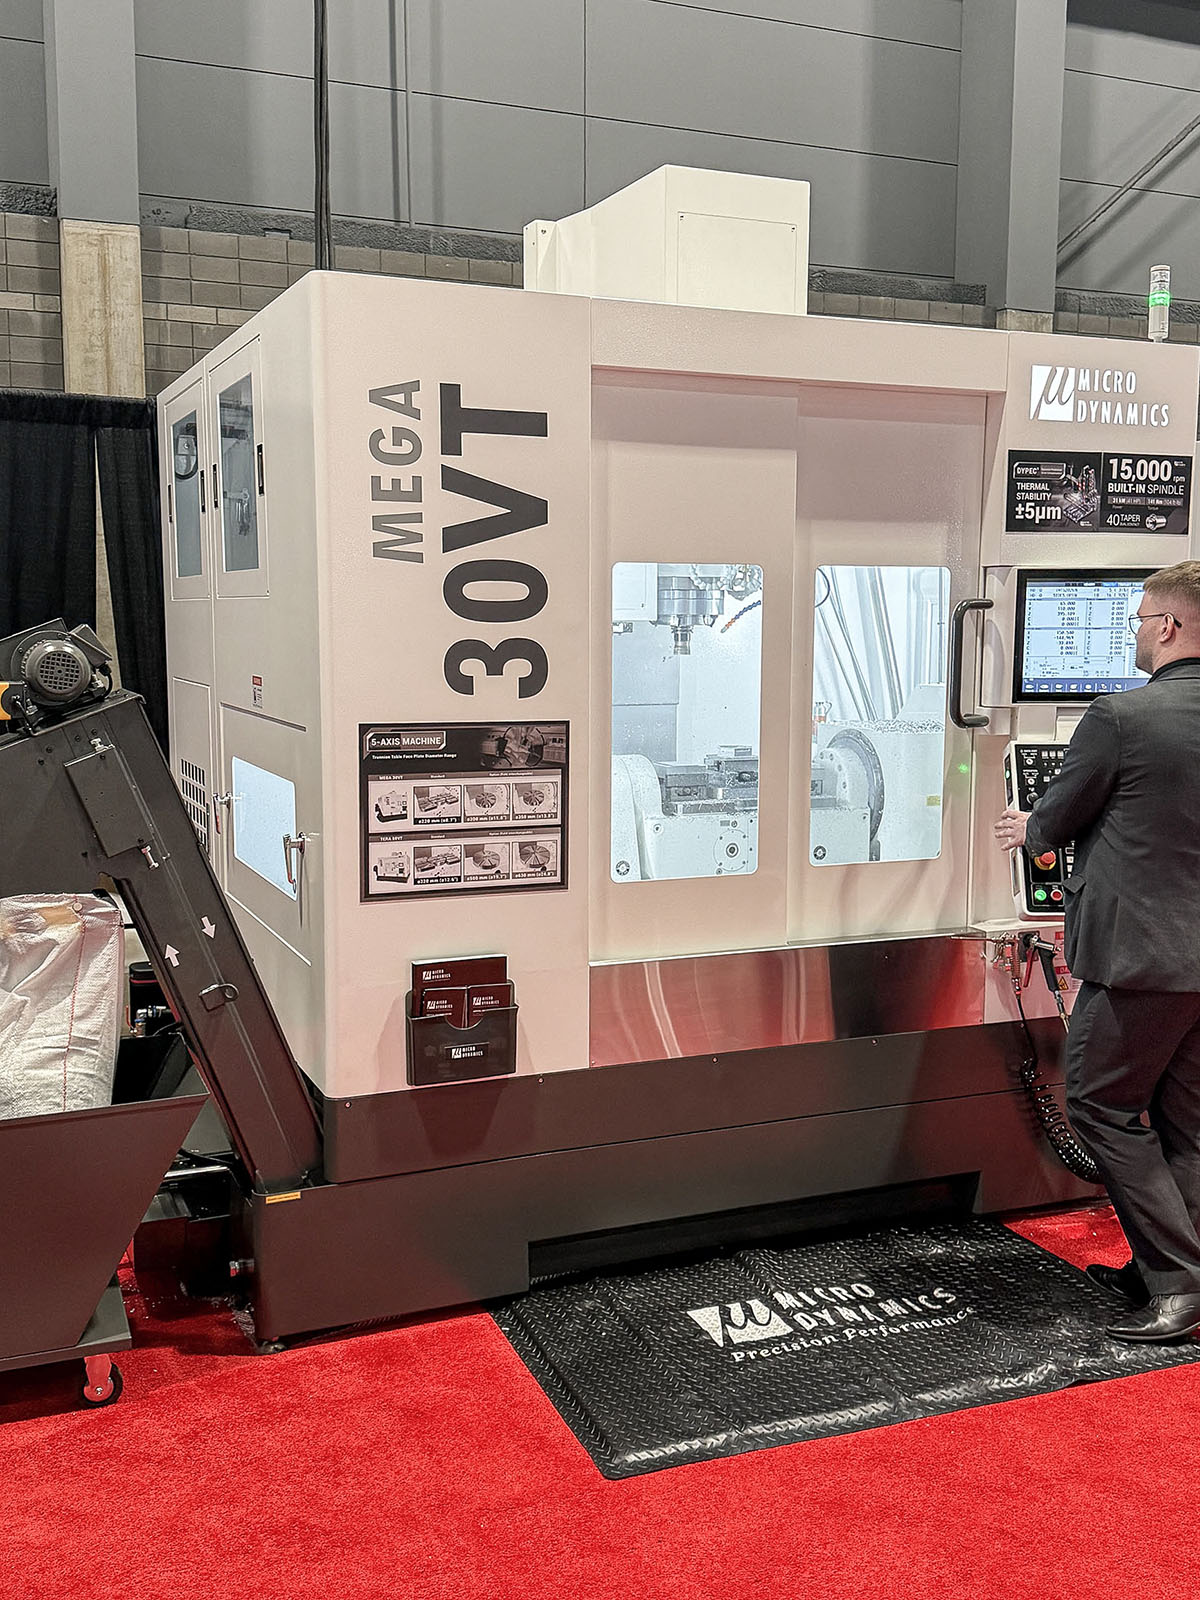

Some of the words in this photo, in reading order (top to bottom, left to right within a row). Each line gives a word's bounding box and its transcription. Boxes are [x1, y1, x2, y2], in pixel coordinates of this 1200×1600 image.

[1078, 368, 1136, 394] MICRO
[1077, 400, 1169, 427] DYNAMICS
[368, 379, 424, 564] MEGA
[1109, 458, 1172, 482] 15,000
[1016, 482, 1050, 490] THERMAL
[1016, 492, 1052, 500] STABILITY
[1108, 482, 1146, 494] BUILT-IN
[1147, 484, 1184, 495] SPINDLE
[1015, 502, 1062, 524] ±5µm
[1106, 514, 1120, 526] 40
[440, 382, 548, 700] 30VT
[402, 737, 441, 745] MACHINE
[773, 1283, 876, 1311] MICRO
[793, 1288, 956, 1331] DYNAMICS
[732, 1334, 838, 1362] Precision
[843, 1306, 976, 1340] Performance
